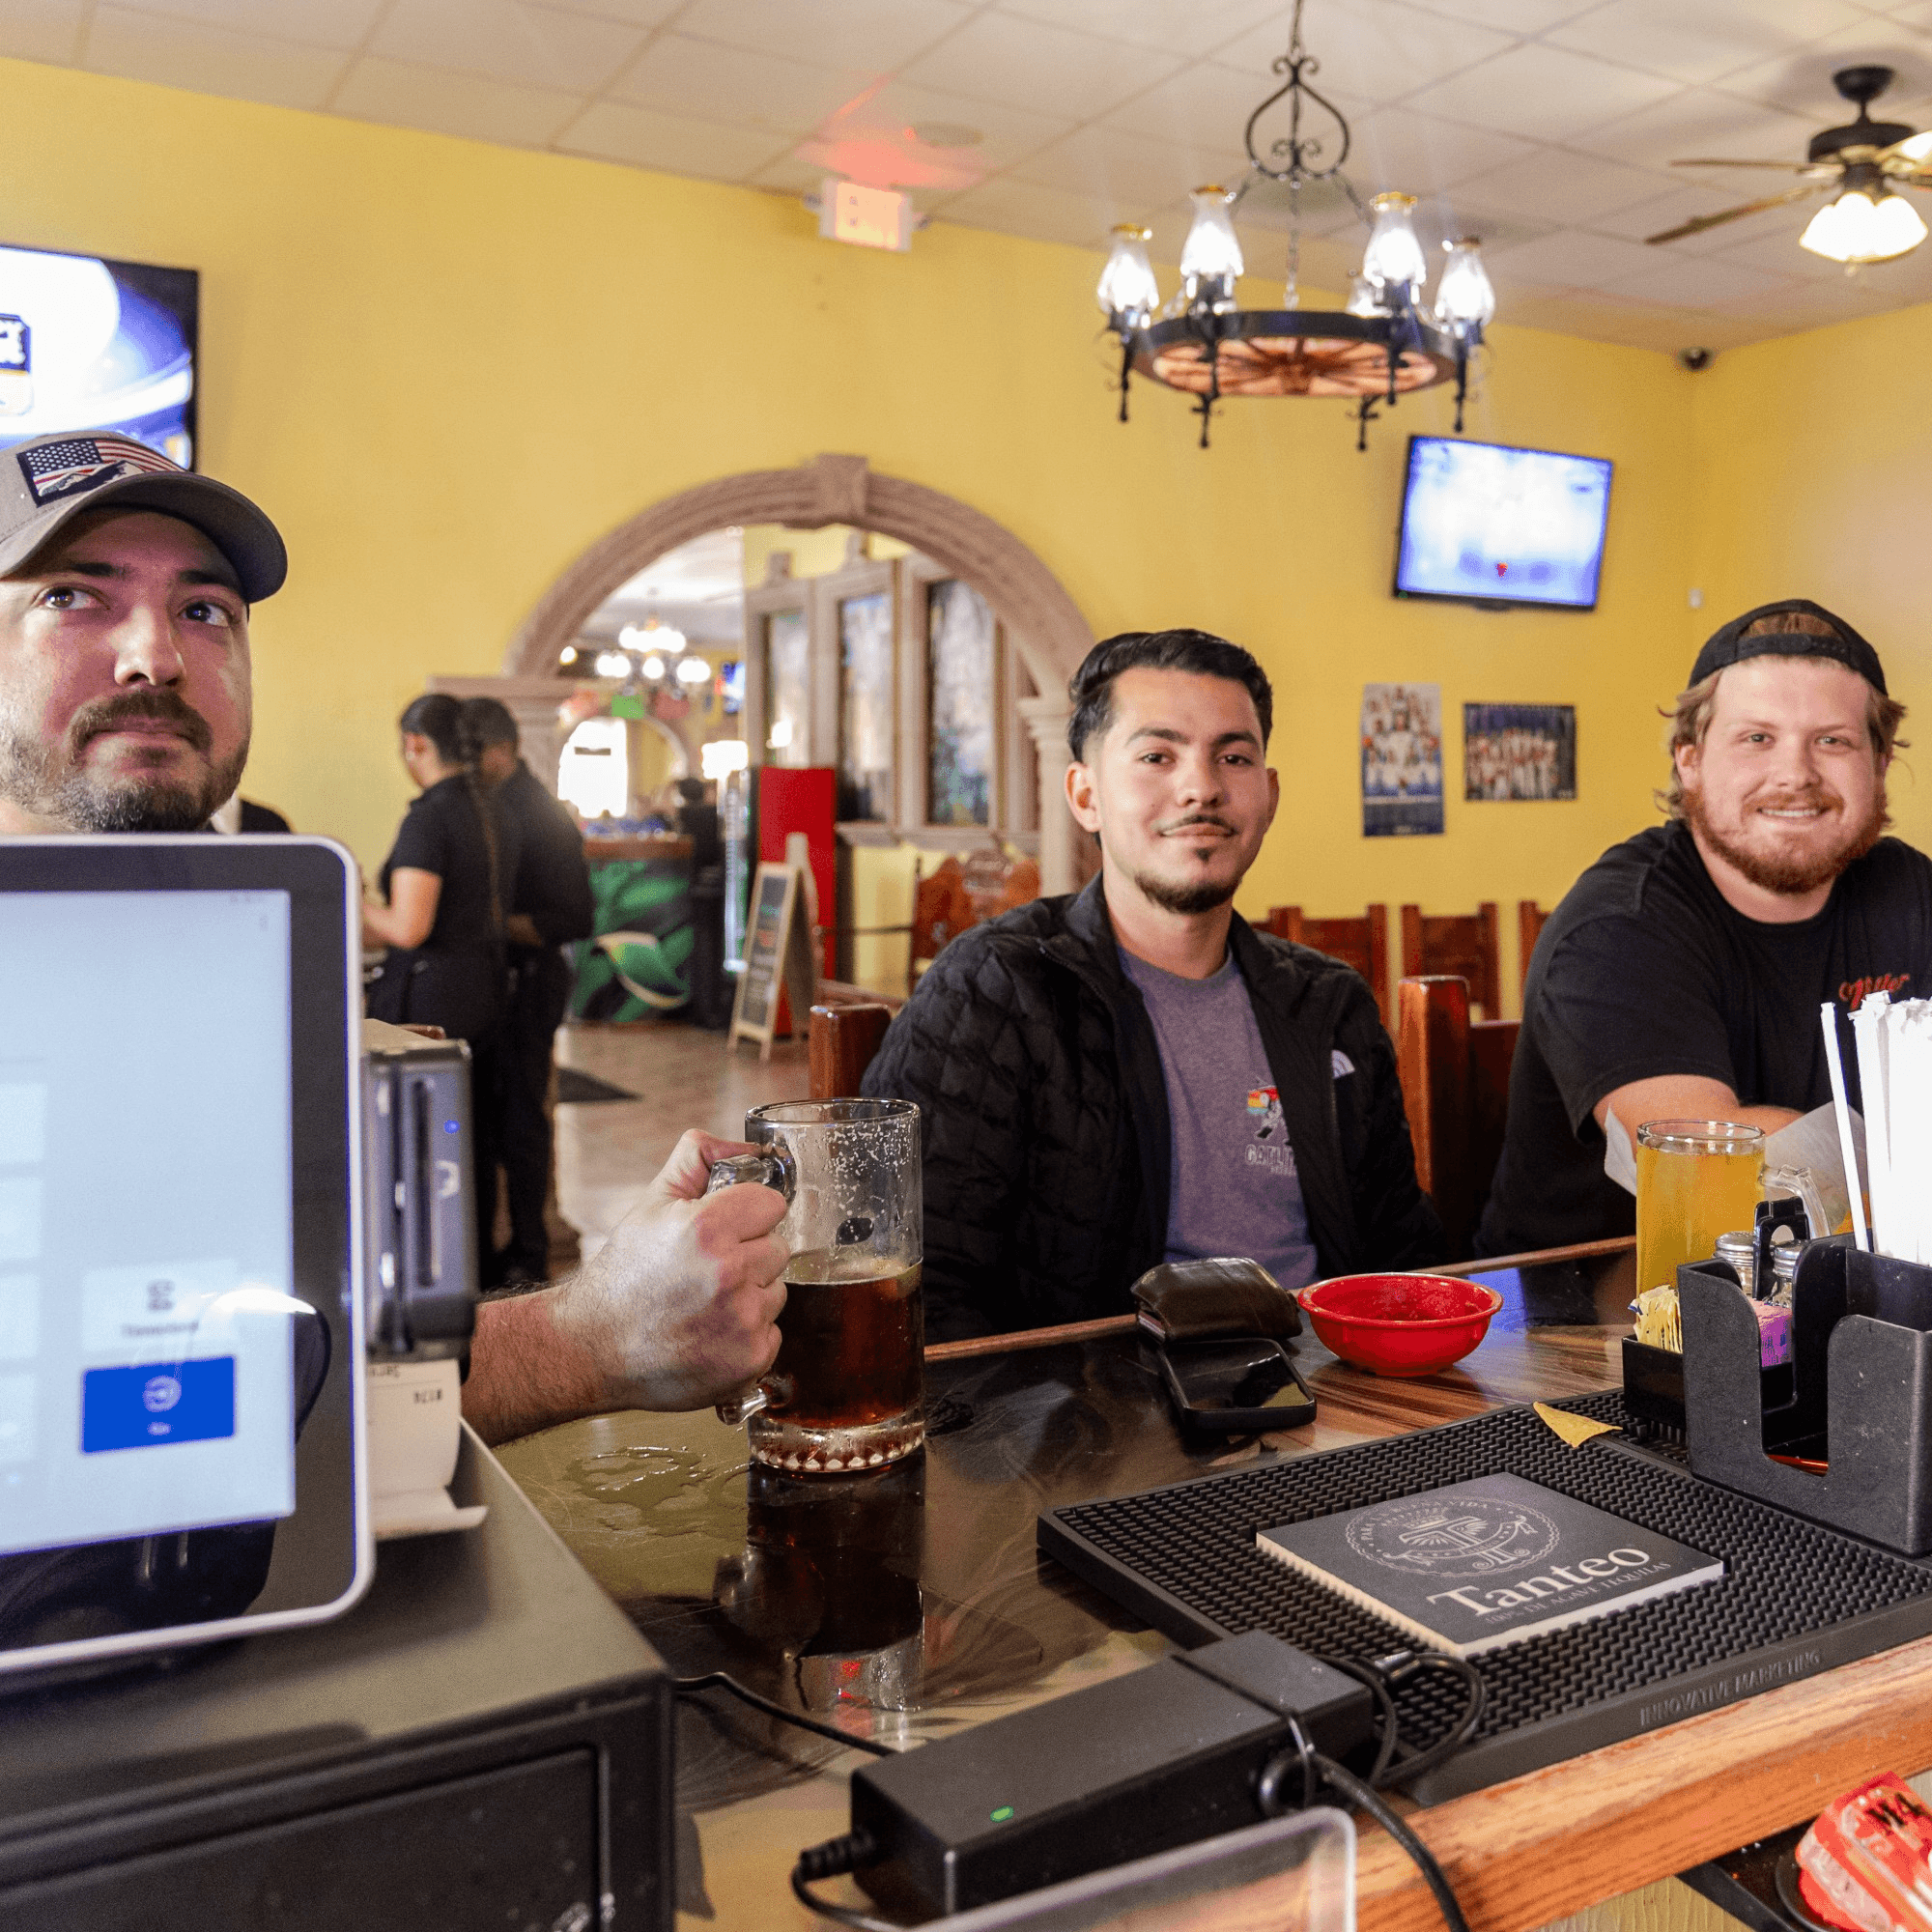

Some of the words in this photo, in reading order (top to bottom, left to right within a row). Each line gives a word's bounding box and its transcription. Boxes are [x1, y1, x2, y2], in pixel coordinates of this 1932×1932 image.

[1426, 1548, 1650, 1617] Tanteo
[1549, 1584, 1601, 1605] AGAVE
[1600, 1562, 1672, 1589] TEQUILAS
[1640, 1681, 1728, 1725] INNOVATIVE
[1735, 1651, 1821, 1692] MARKETING
